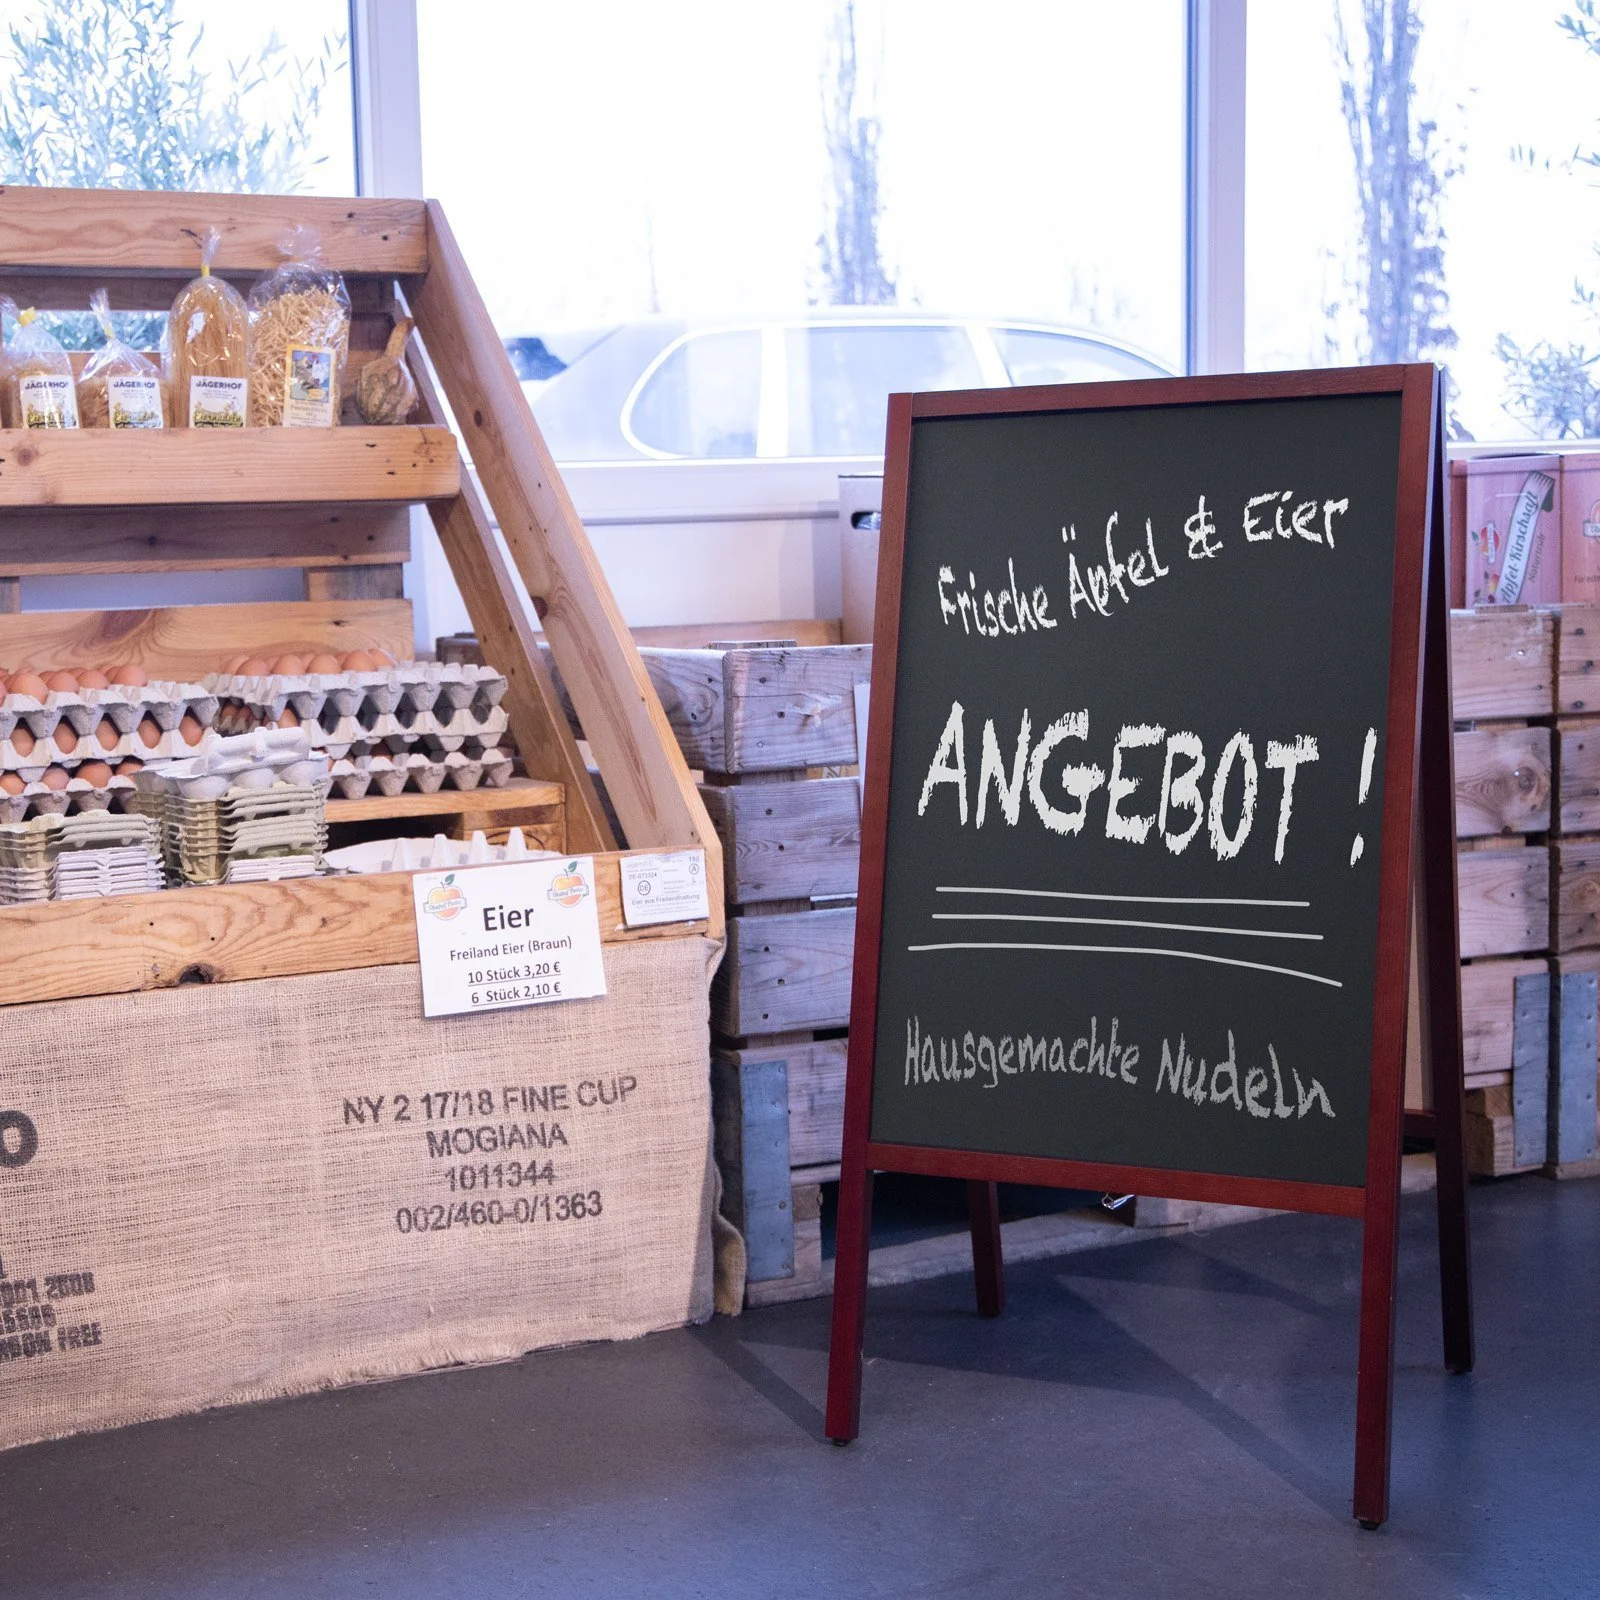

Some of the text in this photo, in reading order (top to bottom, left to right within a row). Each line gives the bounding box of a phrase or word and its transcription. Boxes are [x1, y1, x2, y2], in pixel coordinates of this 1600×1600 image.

[196, 379, 242, 390] JÄGERHOF
[937, 490, 1349, 637] Frische Äpfel & Eier
[918, 700, 1320, 865] ANGEBOT
[483, 905, 534, 931] Eier
[450, 936, 572, 961] Freiland Eier (Braun)
[468, 961, 561, 984] 10 Stück 3,20 €
[471, 982, 561, 1004] 6 Stück 2,10 €
[904, 1015, 1140, 1088] Hausgemachte
[343, 1075, 637, 1124] NY 2 17/18 FINE CUP
[426, 1122, 568, 1159] MOGIANA
[445, 1160, 556, 1192] 1011344
[396, 1190, 603, 1233] 002/460-0/1363
